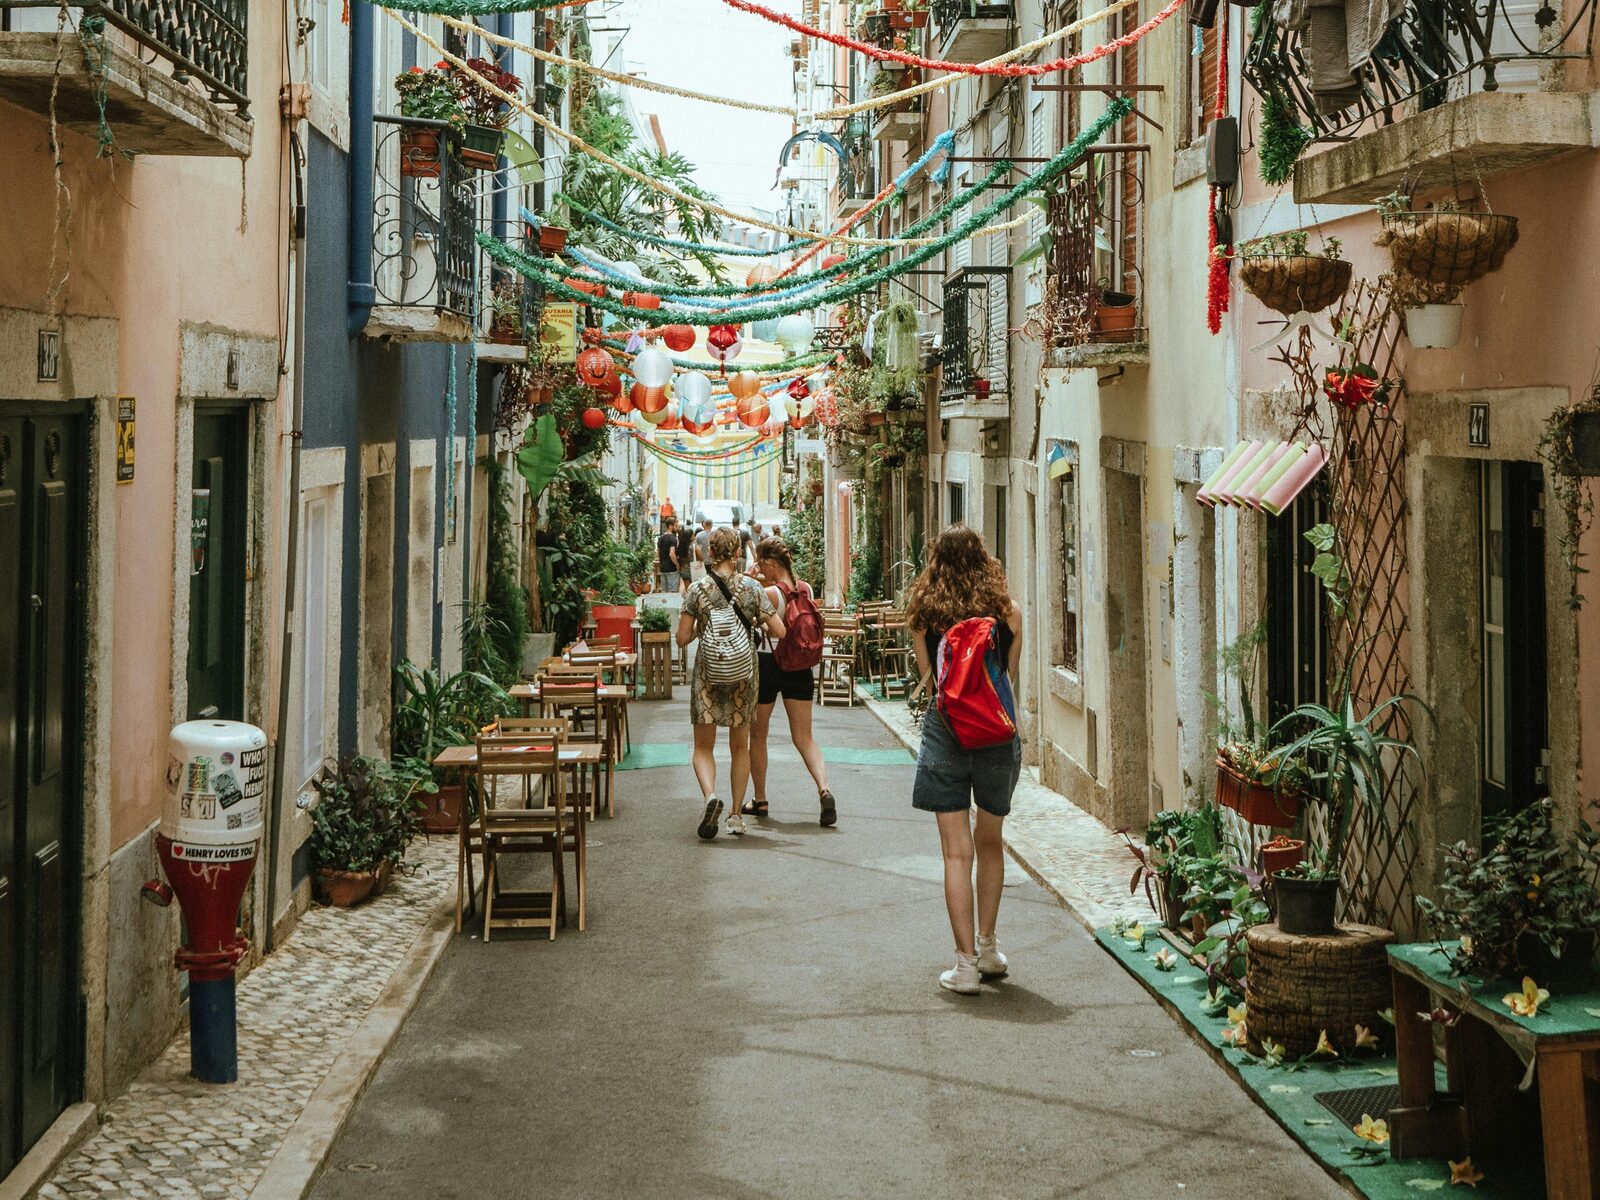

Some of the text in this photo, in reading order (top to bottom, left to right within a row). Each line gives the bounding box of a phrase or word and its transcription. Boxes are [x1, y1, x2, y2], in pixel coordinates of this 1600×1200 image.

[243, 750, 262, 767] WHO
[185, 846, 253, 859] HENRY LOVES YOU
